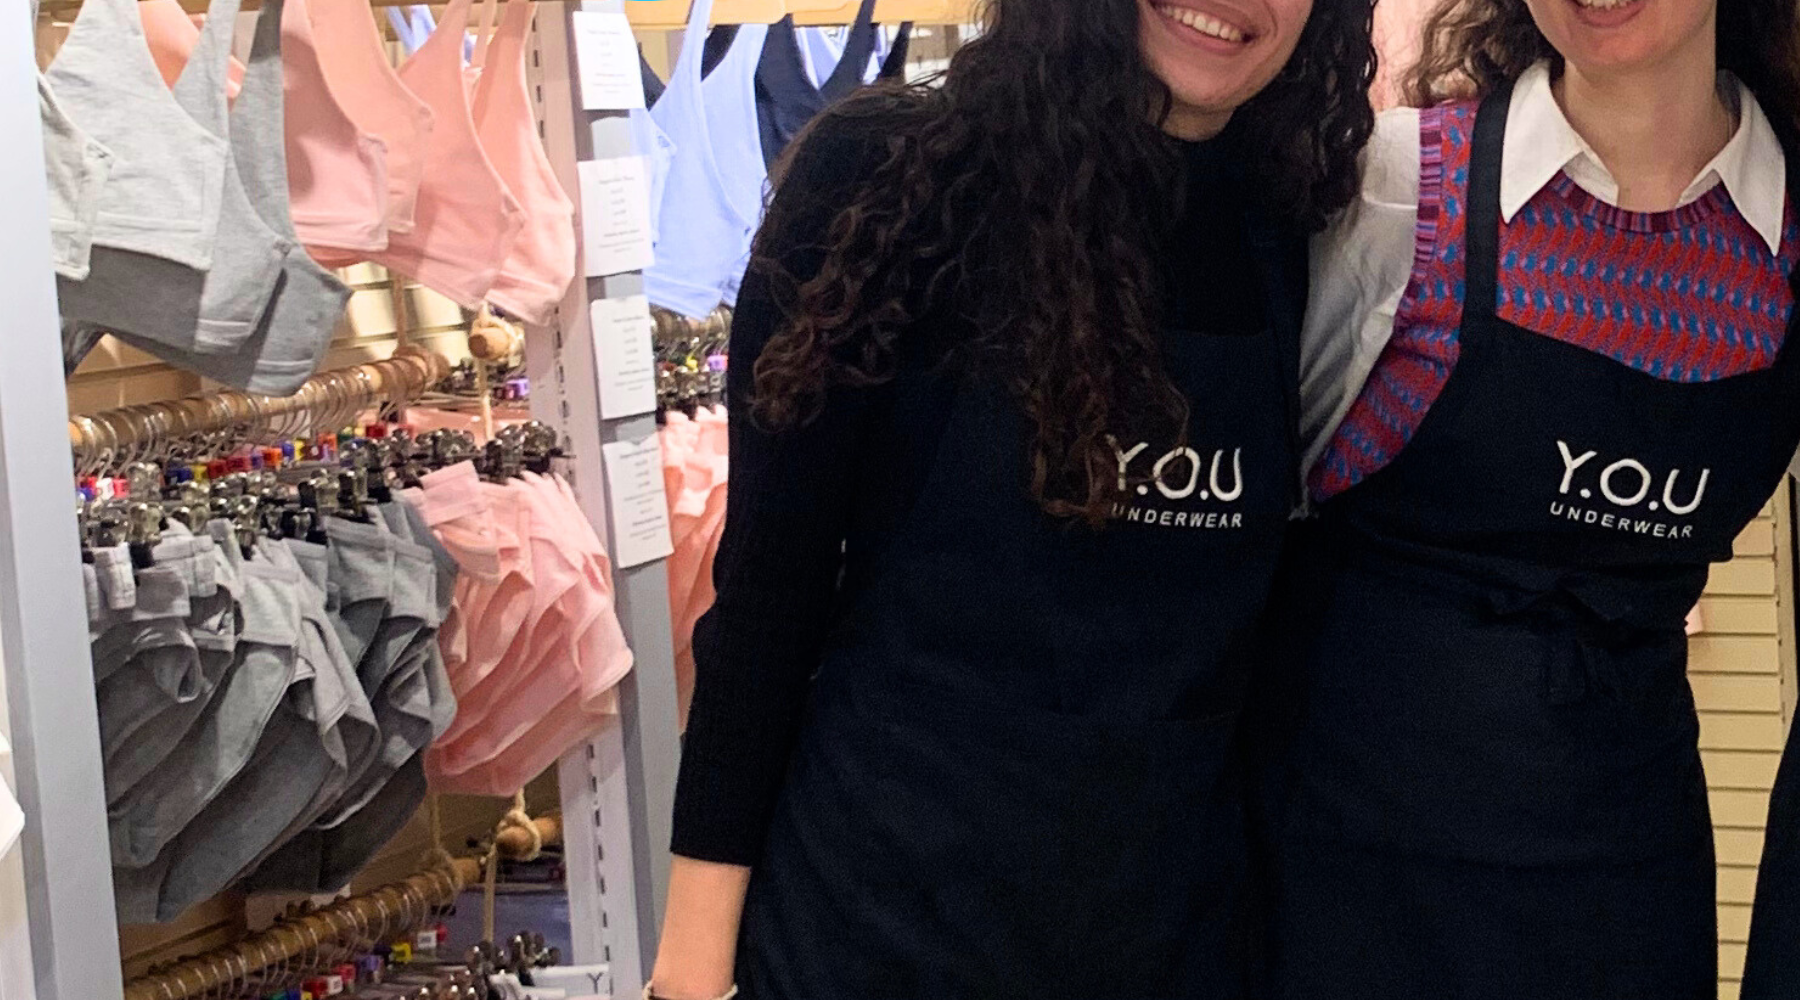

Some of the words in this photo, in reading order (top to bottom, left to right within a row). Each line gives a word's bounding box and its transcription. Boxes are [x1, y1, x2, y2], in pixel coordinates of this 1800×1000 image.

[1105, 434, 1243, 501] Y.O.U
[1556, 440, 1710, 515] Y.O.U
[1549, 501, 1694, 540] UNDERWEAR
